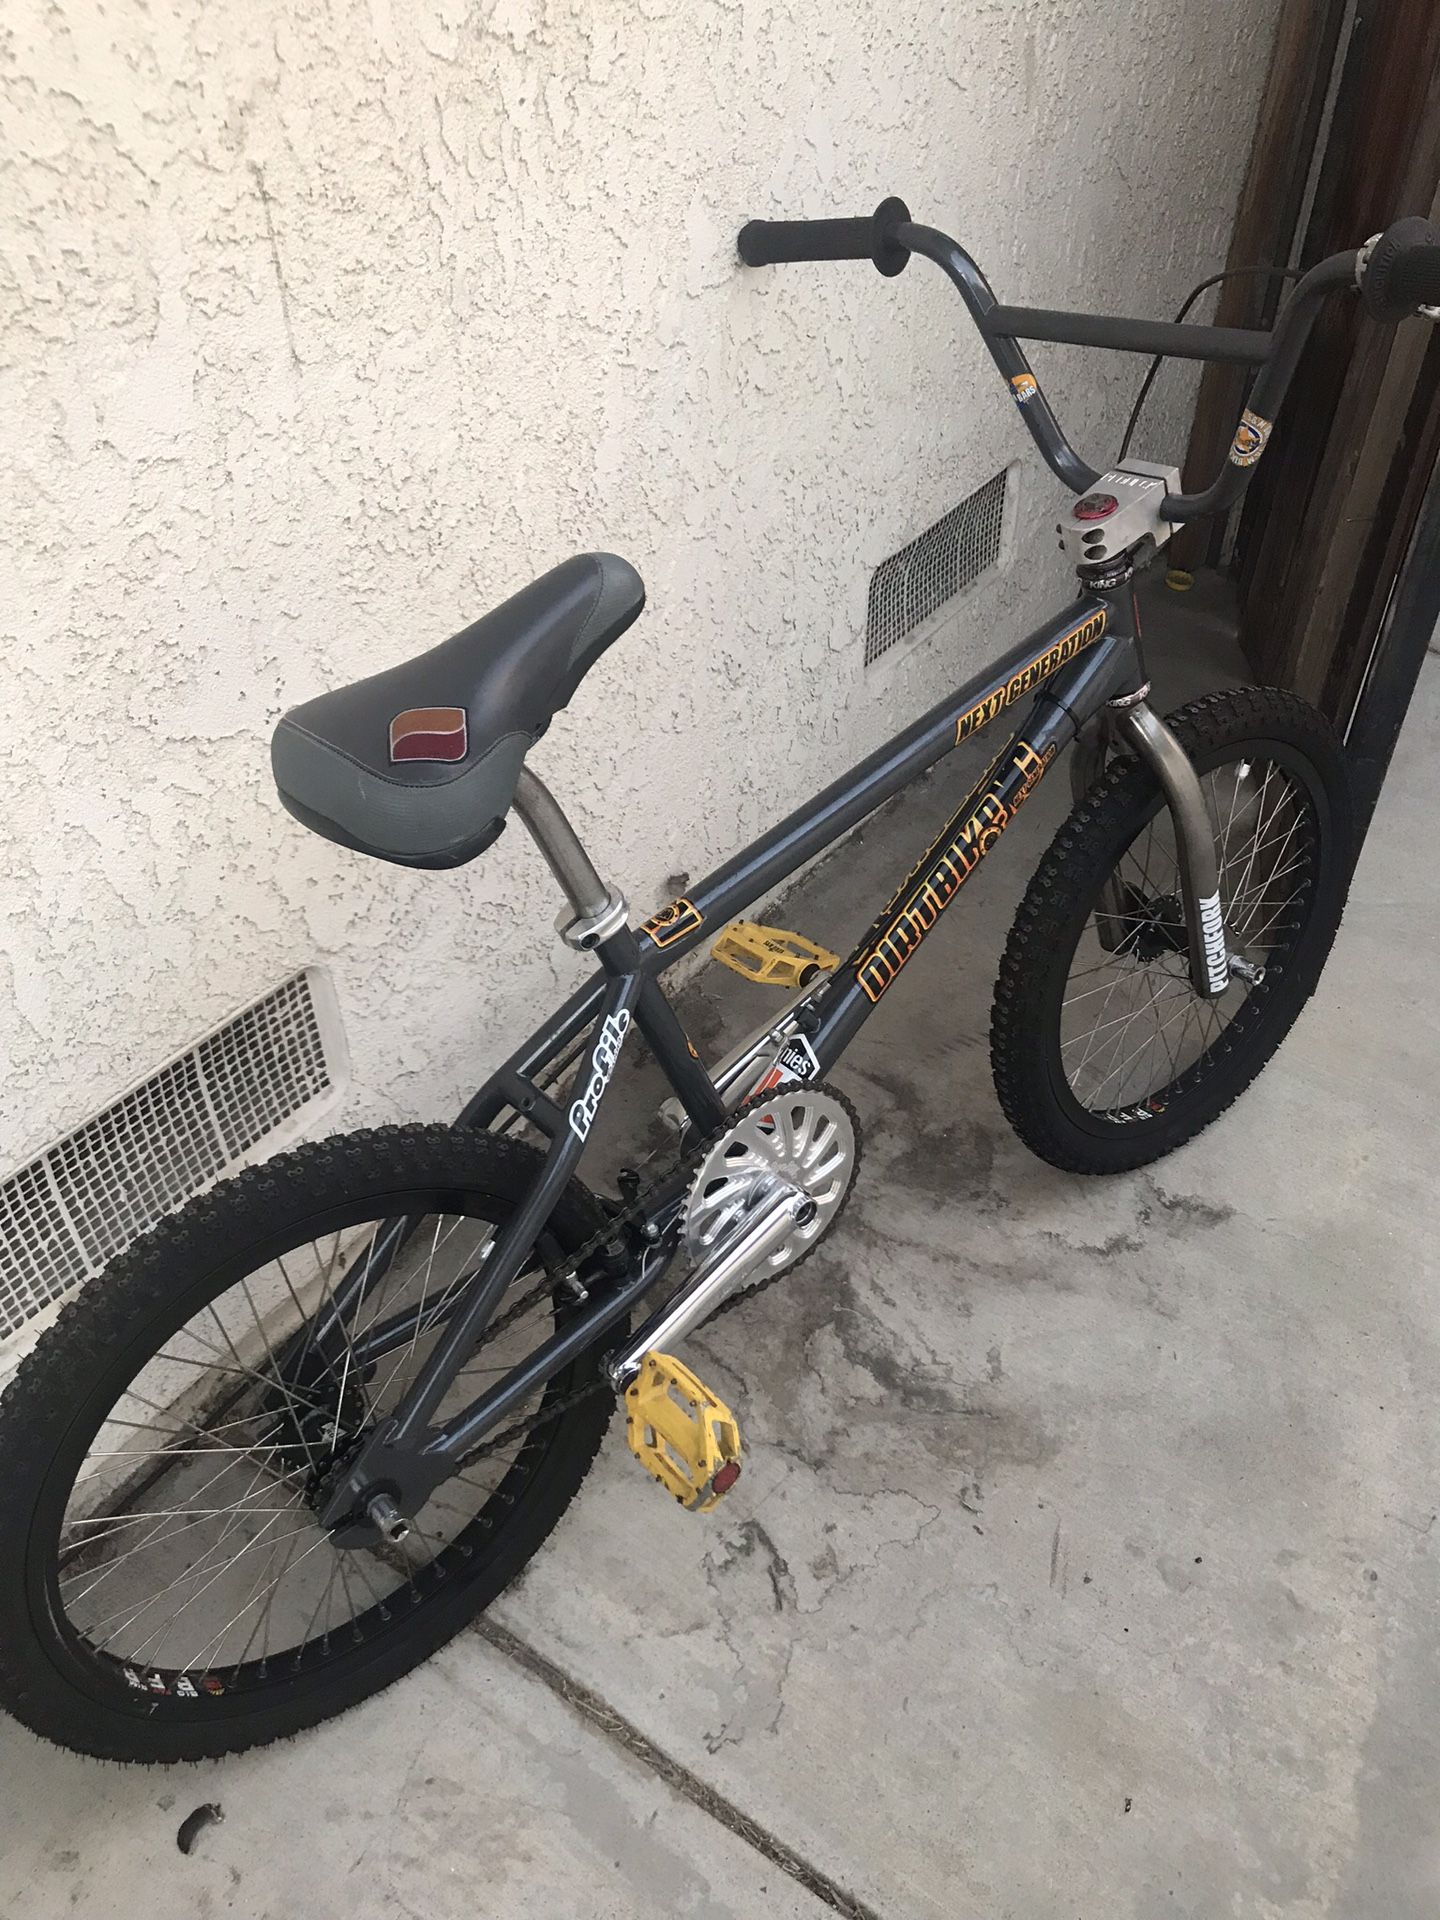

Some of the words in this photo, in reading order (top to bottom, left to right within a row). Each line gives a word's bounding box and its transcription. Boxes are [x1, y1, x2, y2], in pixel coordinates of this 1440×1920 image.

[1089, 578, 1117, 589] KING
[955, 685, 1007, 746] NEXT
[1005, 609, 1108, 706] GENERATION
[1199, 888, 1230, 993] PITCHFORK
[568, 1008, 630, 1143] Profile
